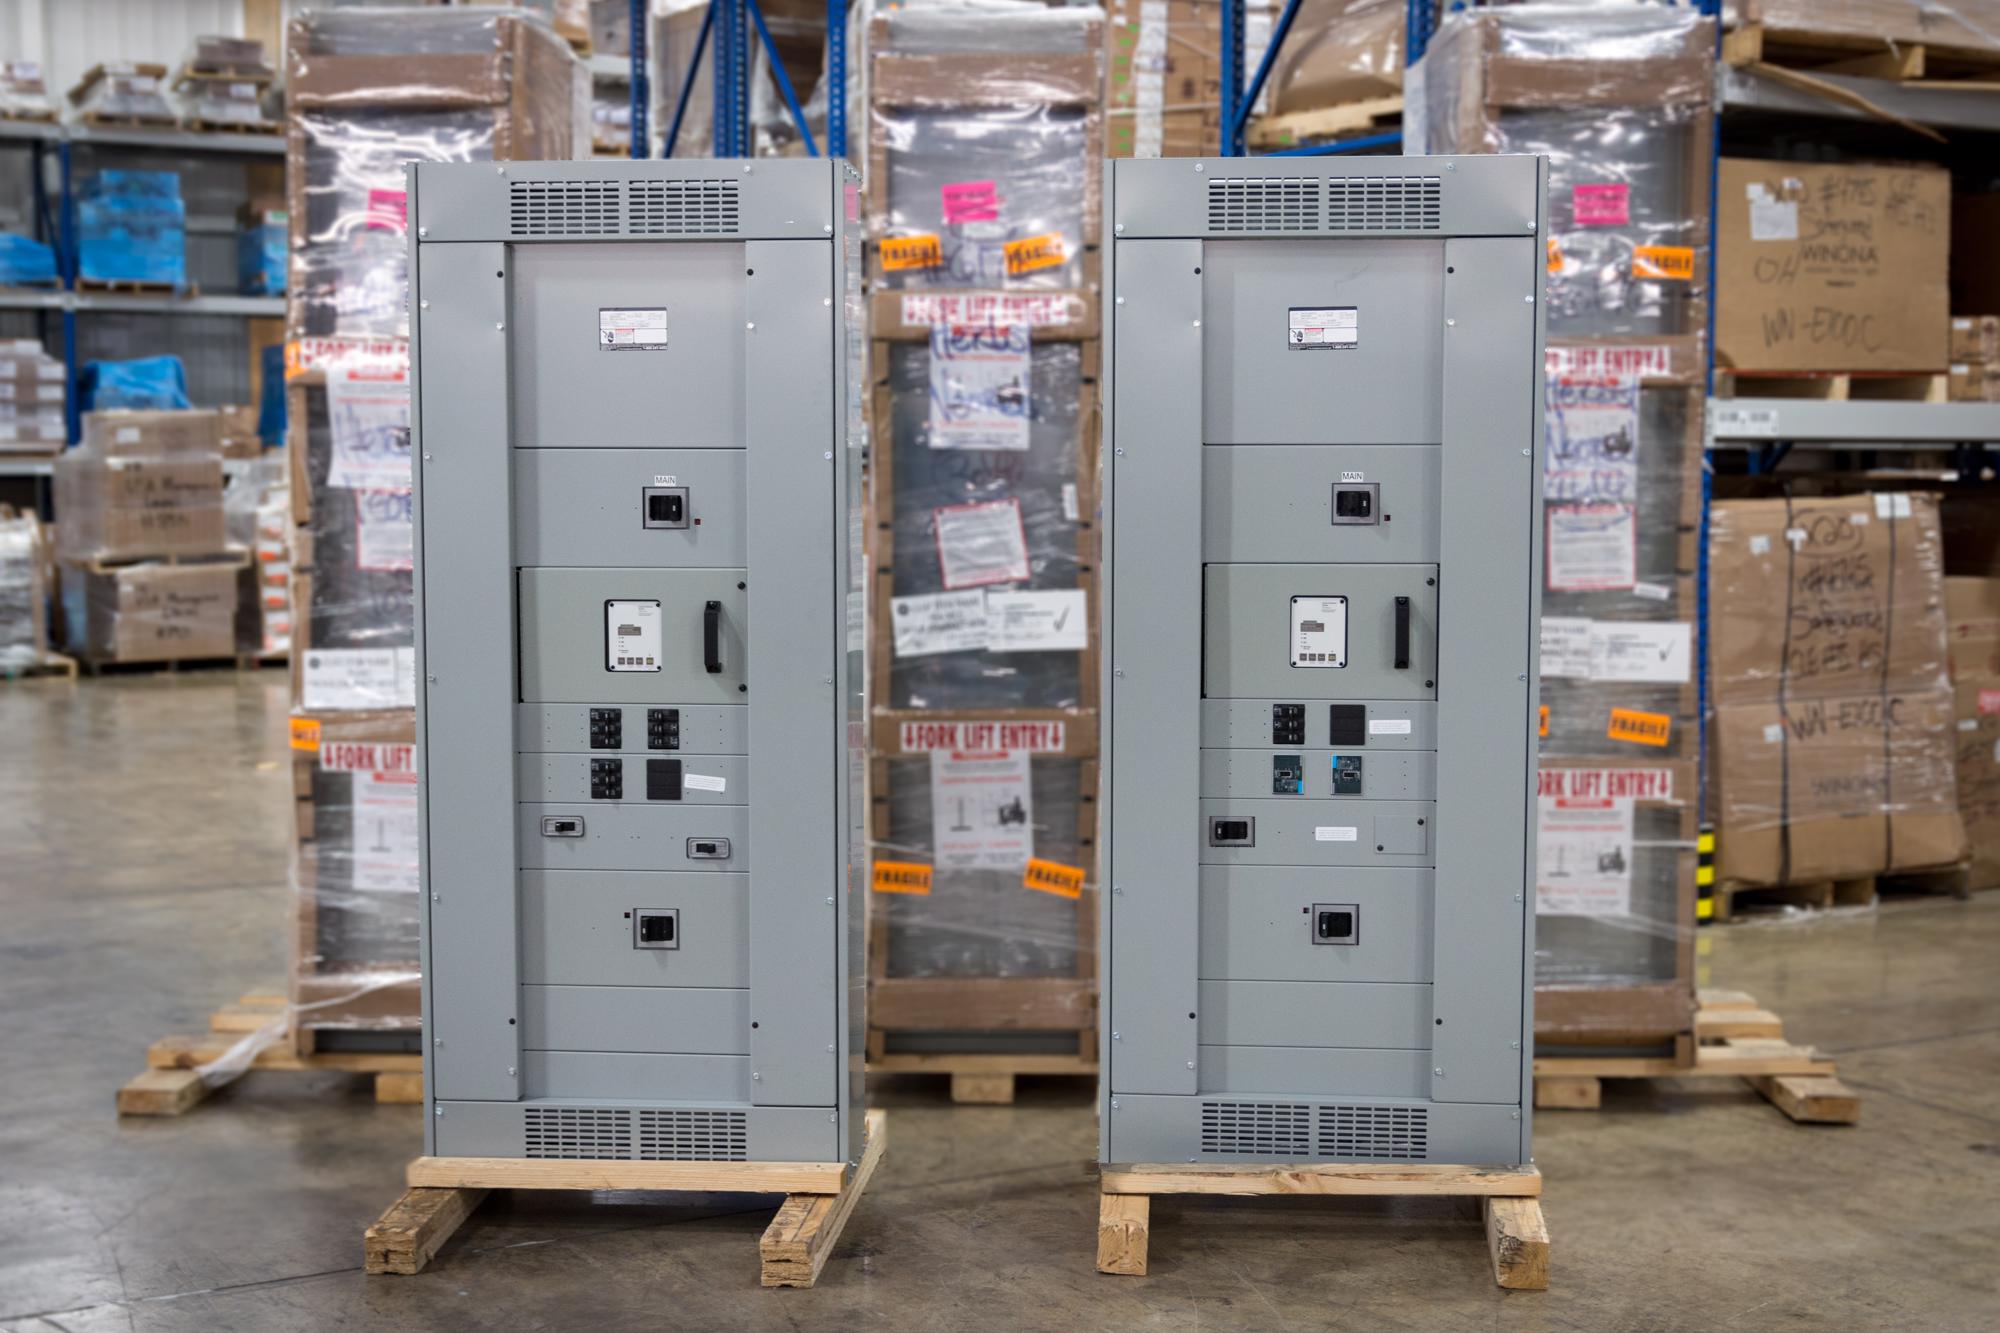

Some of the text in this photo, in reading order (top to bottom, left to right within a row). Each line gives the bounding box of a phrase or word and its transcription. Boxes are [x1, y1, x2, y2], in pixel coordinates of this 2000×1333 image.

[1603, 350, 1653, 374] ENTRY
[655, 476, 675, 484] MAIN
[1342, 472, 1362, 480] MAIN
[916, 723, 1049, 749] FORK LIFT ENTRY
[1611, 716, 1667, 739] FRAGILE
[336, 745, 411, 770] FORK LIFT
[1571, 771, 1601, 796] LIFT
[1608, 771, 1656, 796] ENTRY
[876, 869, 929, 887] FRAGILE
[1026, 866, 1081, 887] FRAGILE
